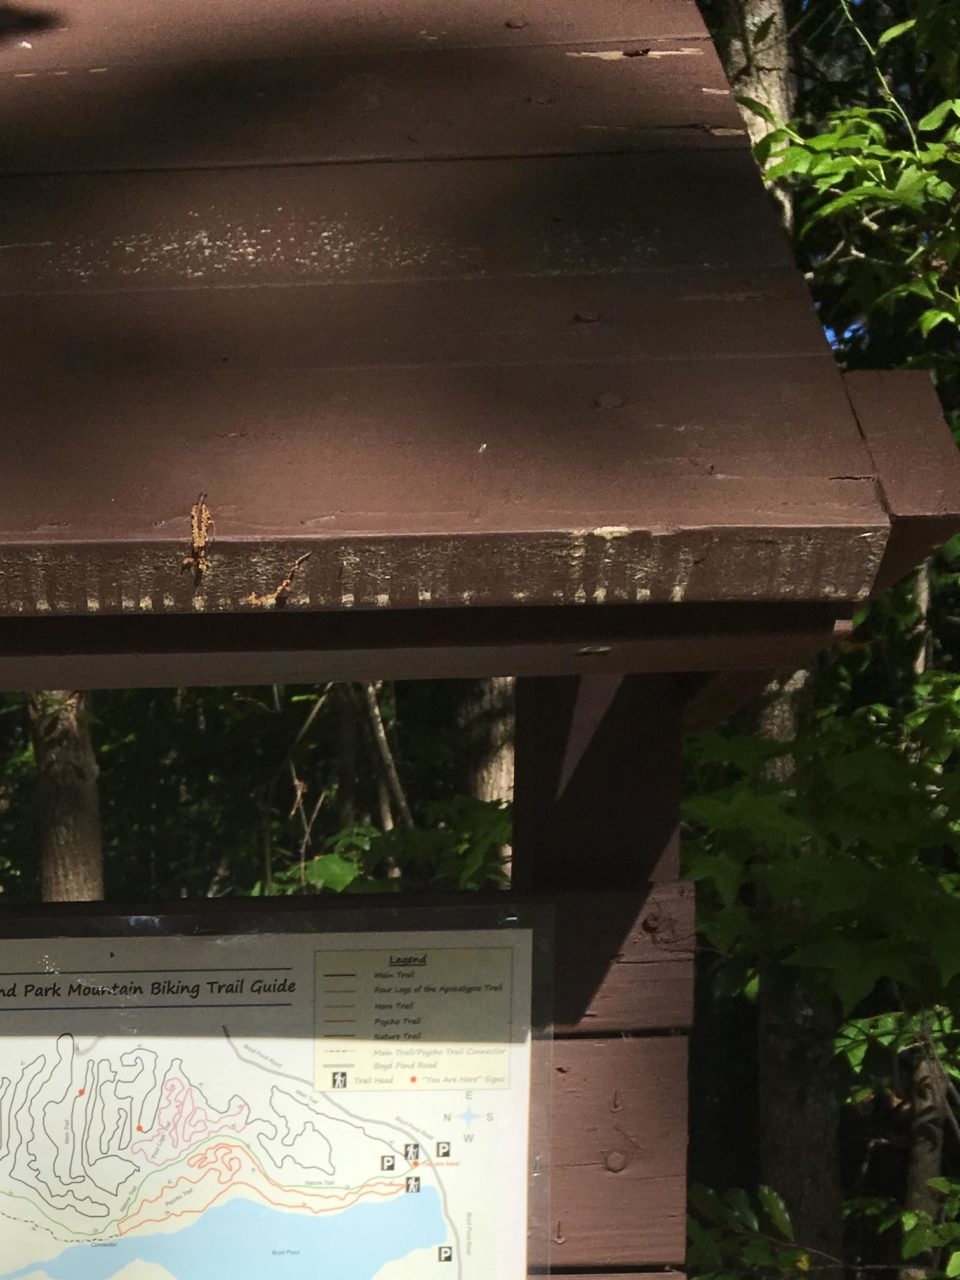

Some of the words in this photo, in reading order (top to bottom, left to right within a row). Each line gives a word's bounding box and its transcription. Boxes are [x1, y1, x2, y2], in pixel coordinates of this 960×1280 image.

[390, 954, 428, 966] Legend
[24, 982, 61, 997] Park
[68, 982, 143, 997] Mountain
[151, 979, 200, 999] Biking
[206, 979, 243, 994] Trail
[250, 979, 296, 994] Guide
[374, 1018, 400, 1027] Psycho
[465, 1091, 473, 1100] E
[444, 1113, 451, 1121] N
[486, 1113, 494, 1121] S
[464, 1134, 474, 1142] W
